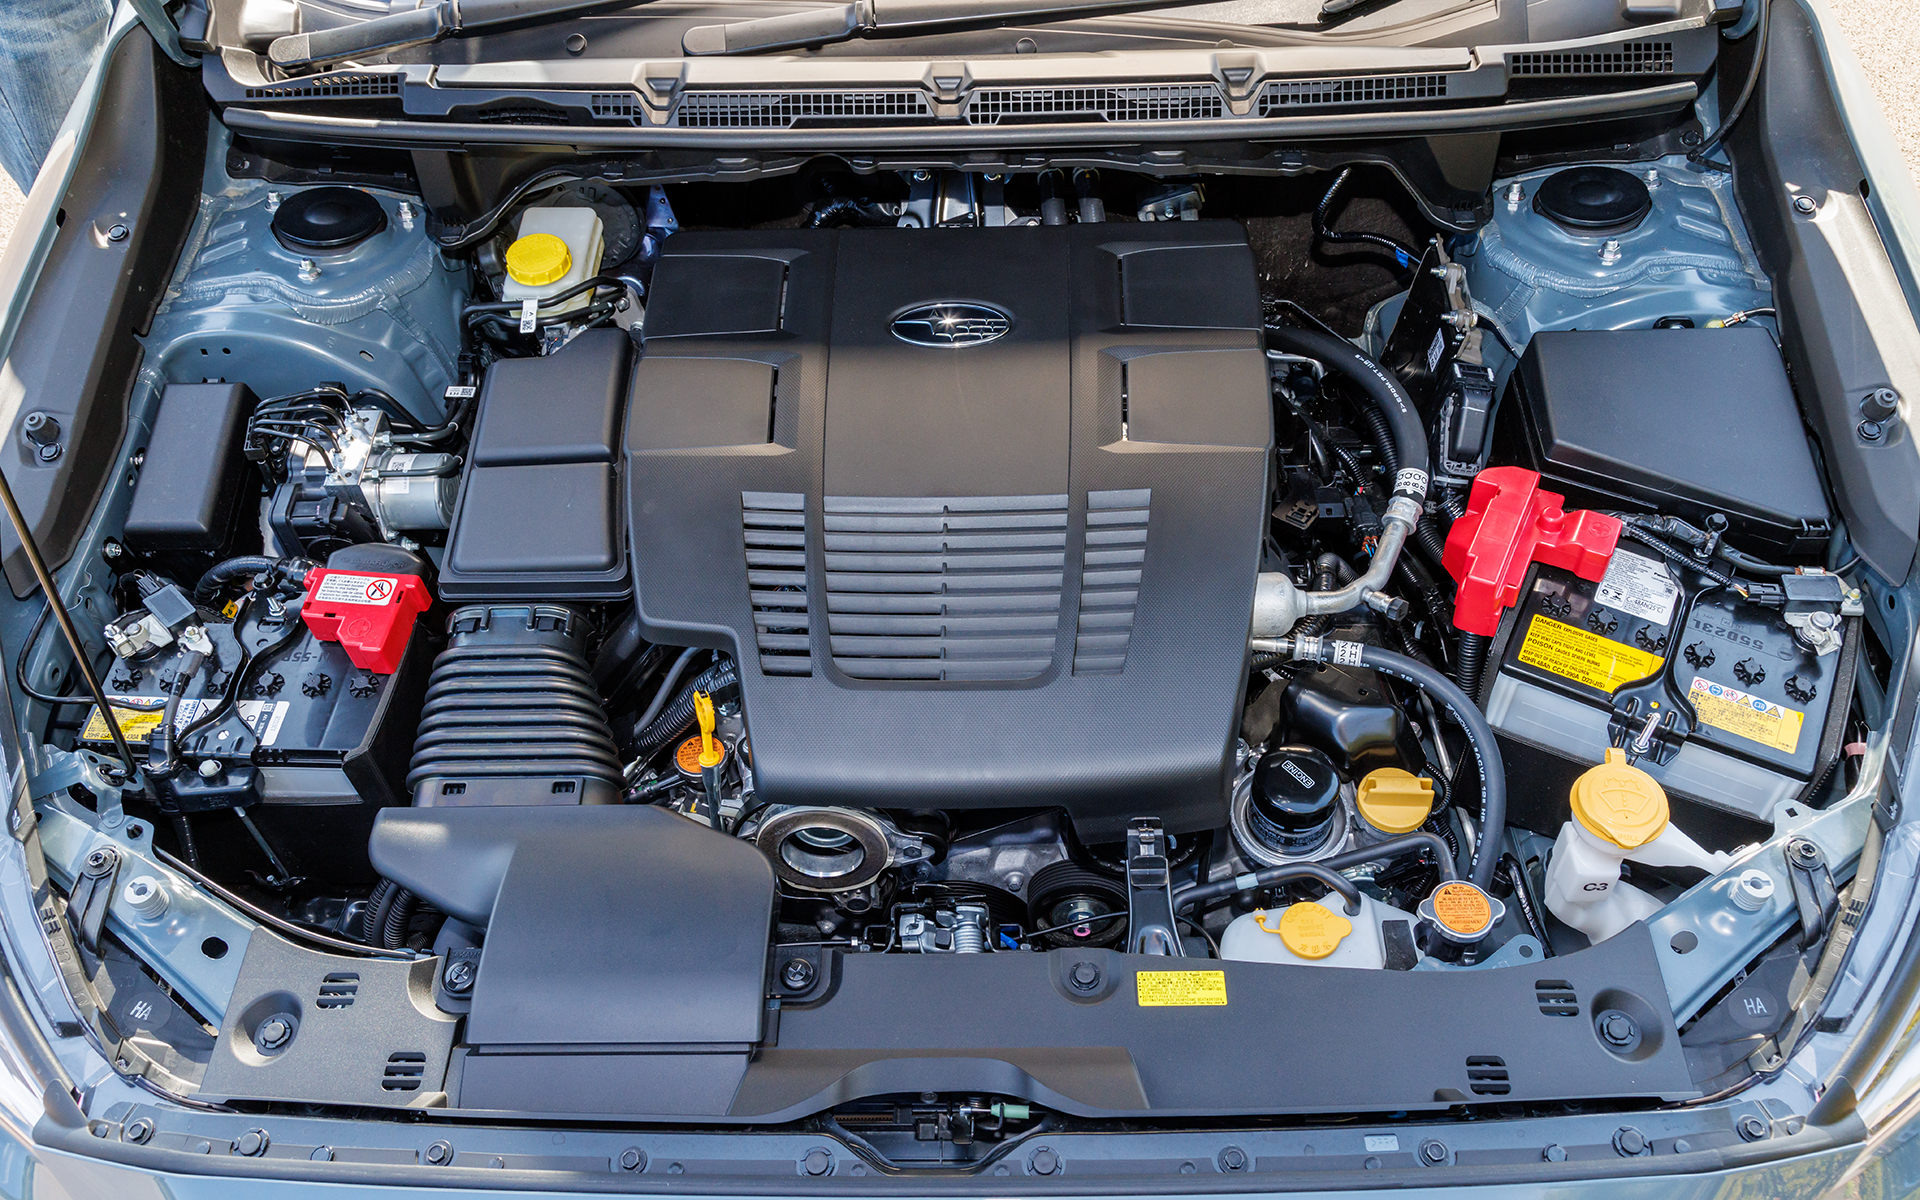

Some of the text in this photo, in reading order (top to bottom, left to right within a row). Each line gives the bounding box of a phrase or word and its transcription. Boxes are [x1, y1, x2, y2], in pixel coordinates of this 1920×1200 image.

[1534, 616, 1598, 642] DANGER EXPLOSIVE GASES
[1693, 618, 1764, 651] 55D23L
[1527, 637, 1554, 650] POISON
[1552, 666, 1565, 674] CCA
[1453, 710, 1475, 744] YOKOHAMA
[1284, 762, 1314, 787] ENGINE
[1618, 833, 1641, 842] PULL
[1582, 881, 1609, 892] C3
[1284, 904, 1333, 923] COOLANT
[129, 1000, 152, 1020] HA
[1743, 997, 1768, 1015] HA
